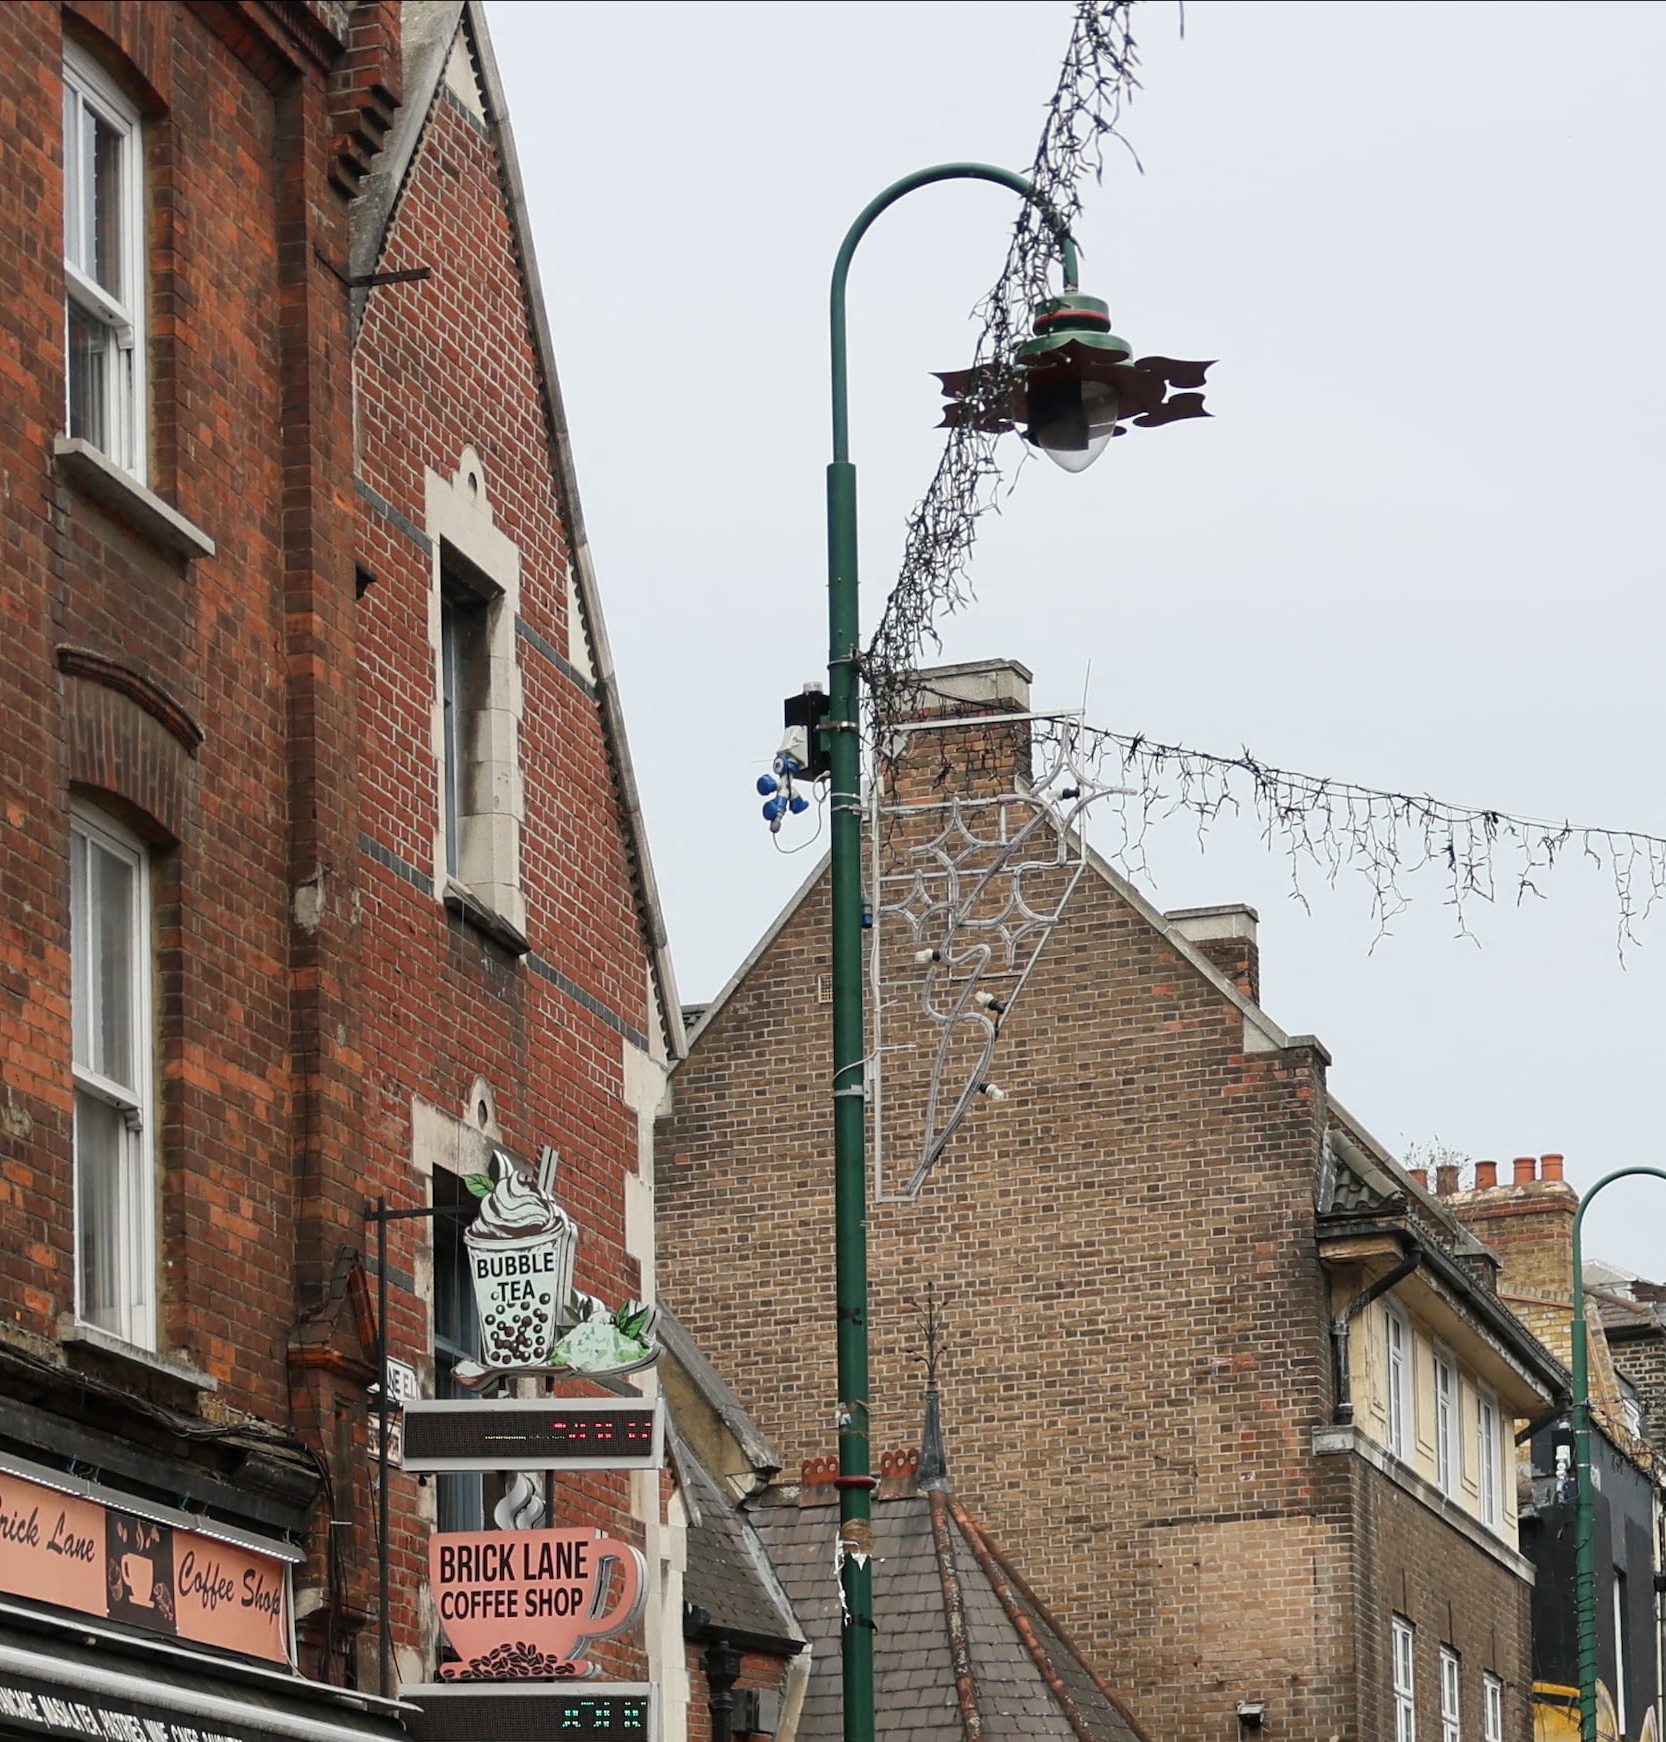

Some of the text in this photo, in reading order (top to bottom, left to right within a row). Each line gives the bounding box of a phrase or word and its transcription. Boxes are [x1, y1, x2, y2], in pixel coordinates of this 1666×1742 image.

[477, 1252, 554, 1279] BUBBLE
[497, 1280, 535, 1302] TEA
[46, 1511, 95, 1563] Lane
[179, 1551, 235, 1610] Coffee
[241, 1568, 281, 1625] Shop
[440, 1541, 589, 1584] BRICK LANE
[440, 1587, 583, 1620] COFFEE SHOP
